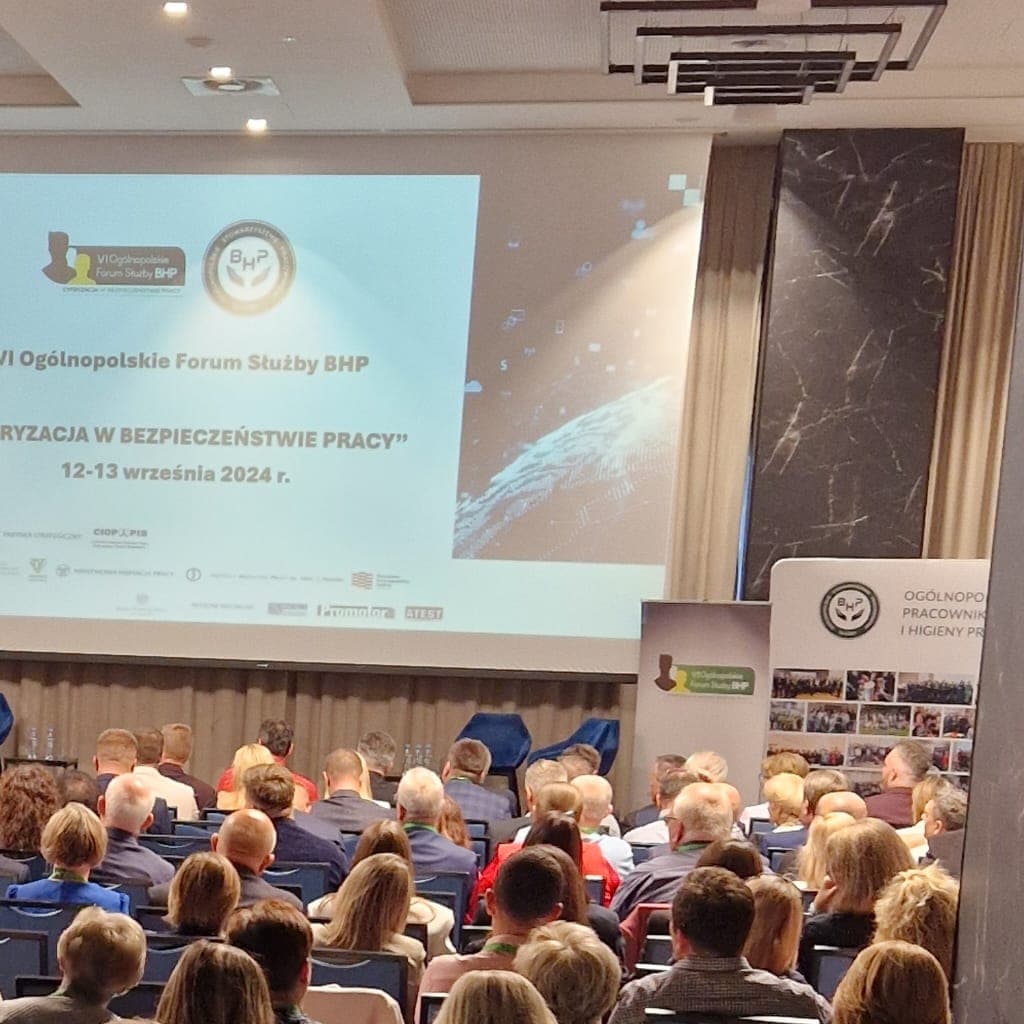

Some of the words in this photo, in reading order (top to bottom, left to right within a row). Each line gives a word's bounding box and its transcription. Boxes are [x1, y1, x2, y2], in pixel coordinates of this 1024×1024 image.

[230, 249, 269, 271] BHP
[96, 267, 122, 278] Forum
[154, 267, 178, 279] BHP
[19, 350, 170, 371] Ogólnopolskie
[175, 352, 242, 370] Forum
[248, 354, 319, 375] Służby
[323, 355, 370, 372] BHP
[93, 426, 116, 443] W
[120, 426, 317, 448] BEZPIECZEŃSTWIE
[61, 462, 118, 479] 12-13
[123, 464, 215, 482] września
[221, 466, 272, 483] 2024
[277, 470, 291, 484] r.
[904, 589, 984, 603] OGÓLNOPO
[837, 597, 863, 612] BHP
[406, 606, 443, 620] ATEST
[900, 625, 905, 636] I
[908, 625, 964, 637] HIGIENY
